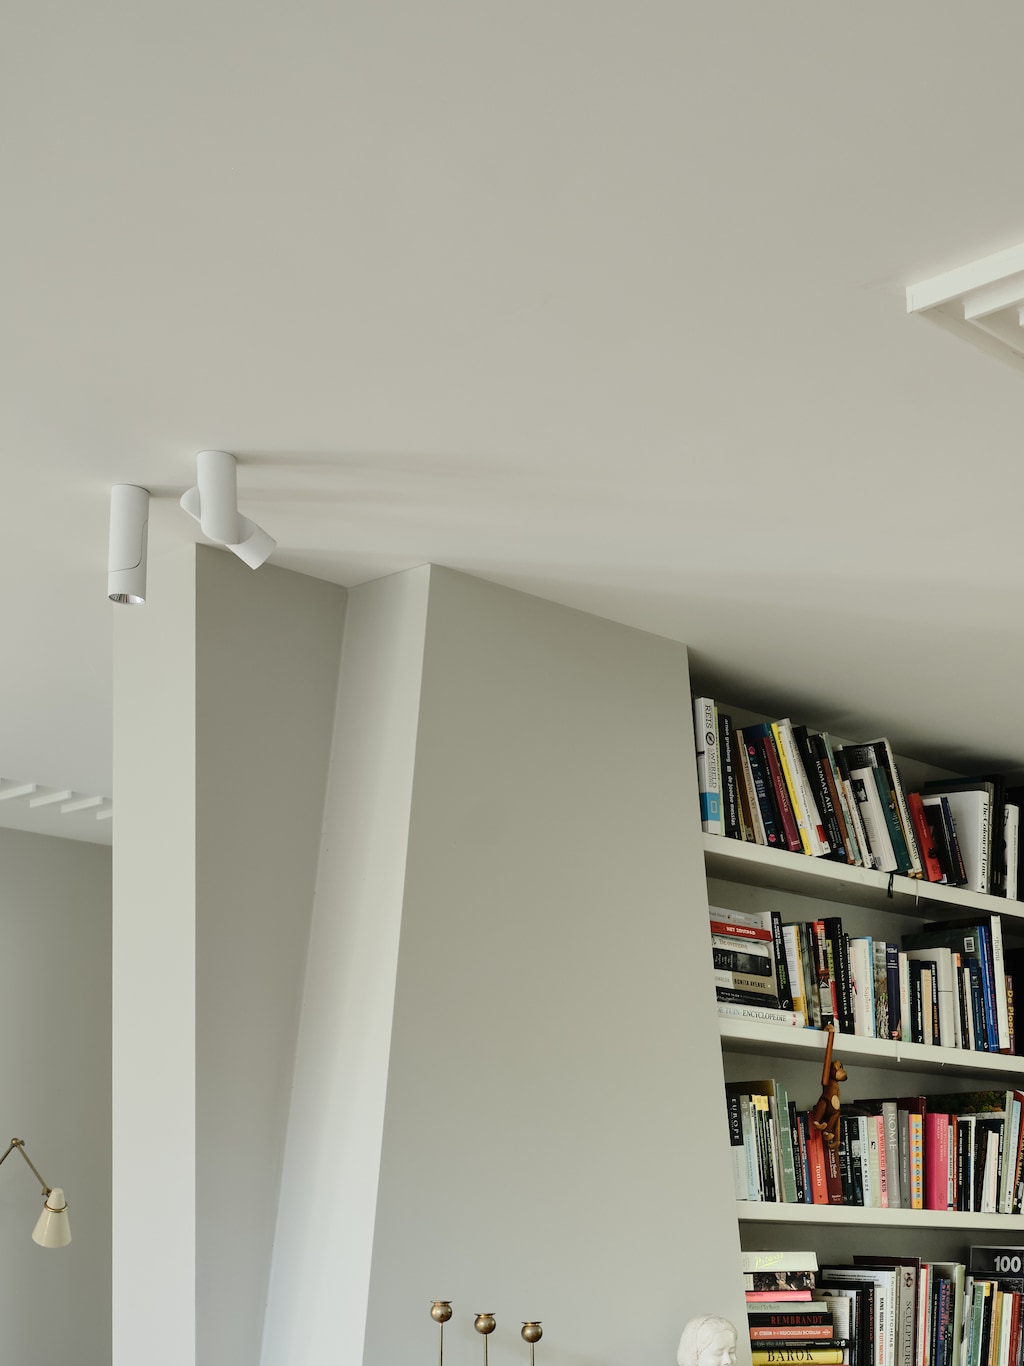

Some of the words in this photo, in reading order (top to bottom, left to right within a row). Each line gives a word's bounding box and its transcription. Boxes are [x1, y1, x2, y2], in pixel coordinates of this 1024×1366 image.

[727, 775, 733, 783] de
[815, 760, 829, 794] ROMAN
[824, 794, 834, 814] ART
[749, 980, 766, 988] AVENUE
[1007, 989, 1013, 1003] De
[725, 1007, 740, 1015] TUIN
[741, 1009, 787, 1022] ENCYCLOPEDIE
[731, 1098, 739, 1139] EUROPE
[886, 1112, 897, 1149] ROME
[880, 1168, 885, 1178] DE
[994, 1255, 1021, 1273] 100
[771, 1315, 823, 1324] REMBRANDT
[768, 1348, 814, 1362] BAROK
